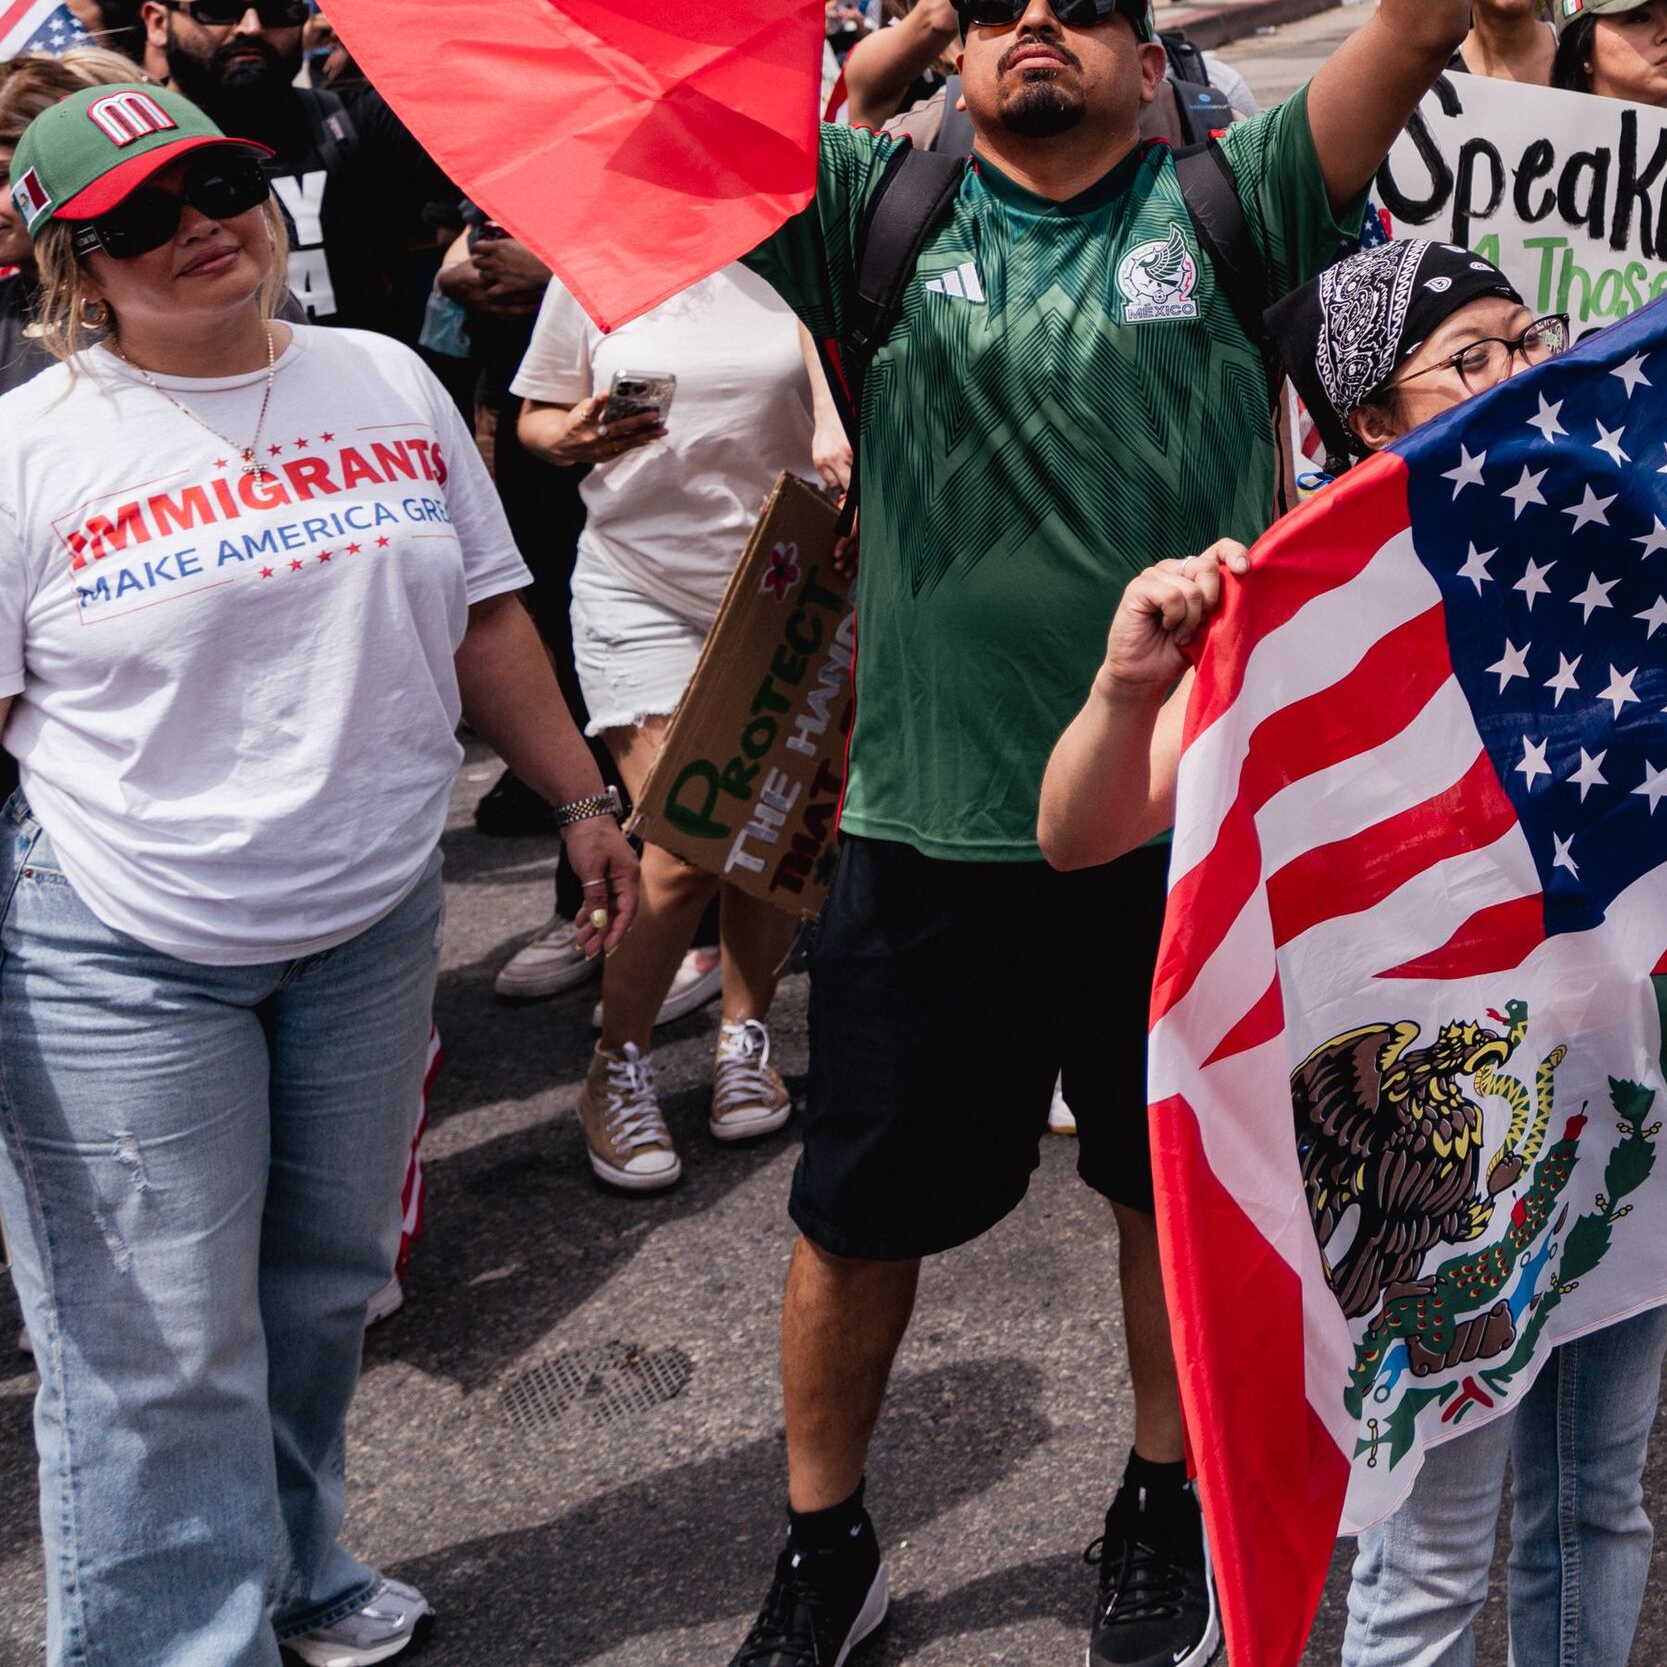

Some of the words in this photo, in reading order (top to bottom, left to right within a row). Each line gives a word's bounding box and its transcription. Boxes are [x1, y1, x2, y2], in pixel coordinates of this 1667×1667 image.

[1127, 301, 1196, 320] MÉXICO
[67, 438, 448, 571] IMMIGRANTS
[76, 547, 203, 607] MAKE
[217, 502, 398, 567] AMERICA
[402, 497, 453, 522] GRE
[725, 767, 802, 874] THE
[786, 581, 859, 758] HAND
